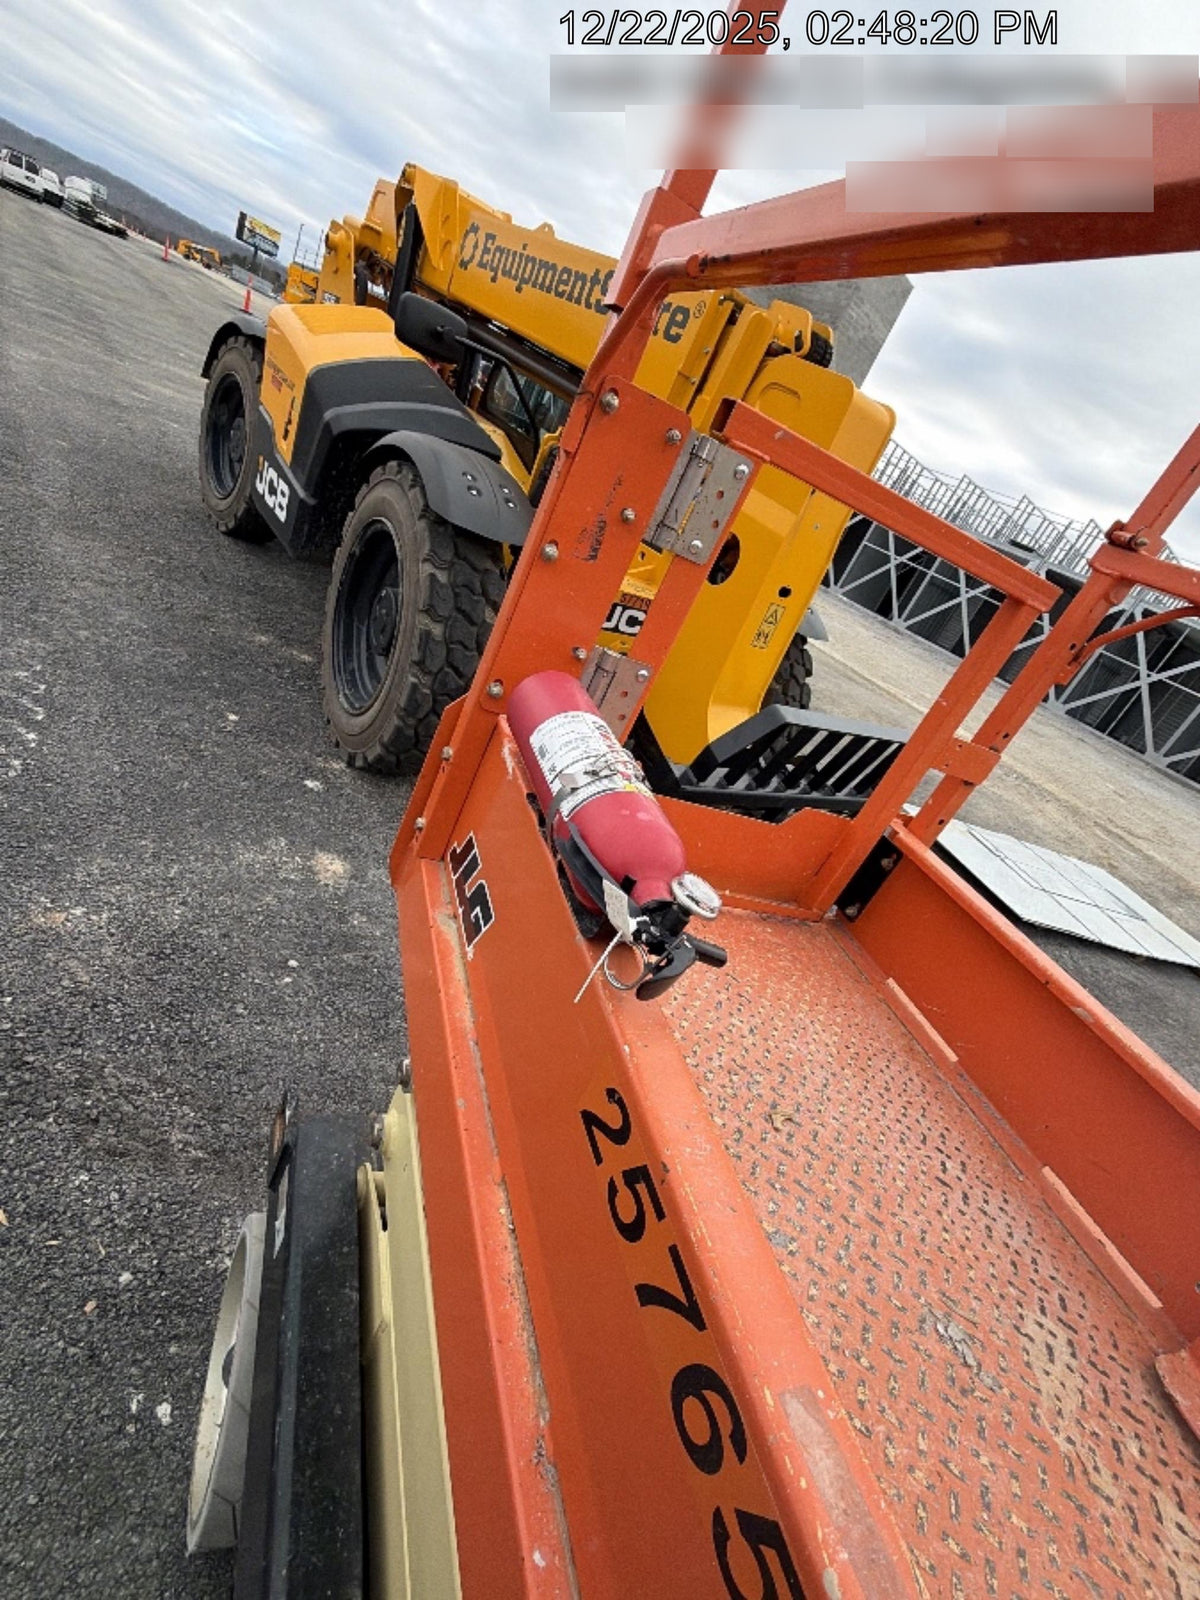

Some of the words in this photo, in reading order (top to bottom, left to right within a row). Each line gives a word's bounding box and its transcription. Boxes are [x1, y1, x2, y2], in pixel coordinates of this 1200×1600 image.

[477, 232, 691, 343] EquipmentSre
[255, 455, 290, 523] JCB
[601, 605, 648, 635] JC
[448, 830, 495, 952] JLG
[580, 1087, 807, 1600] 25765
